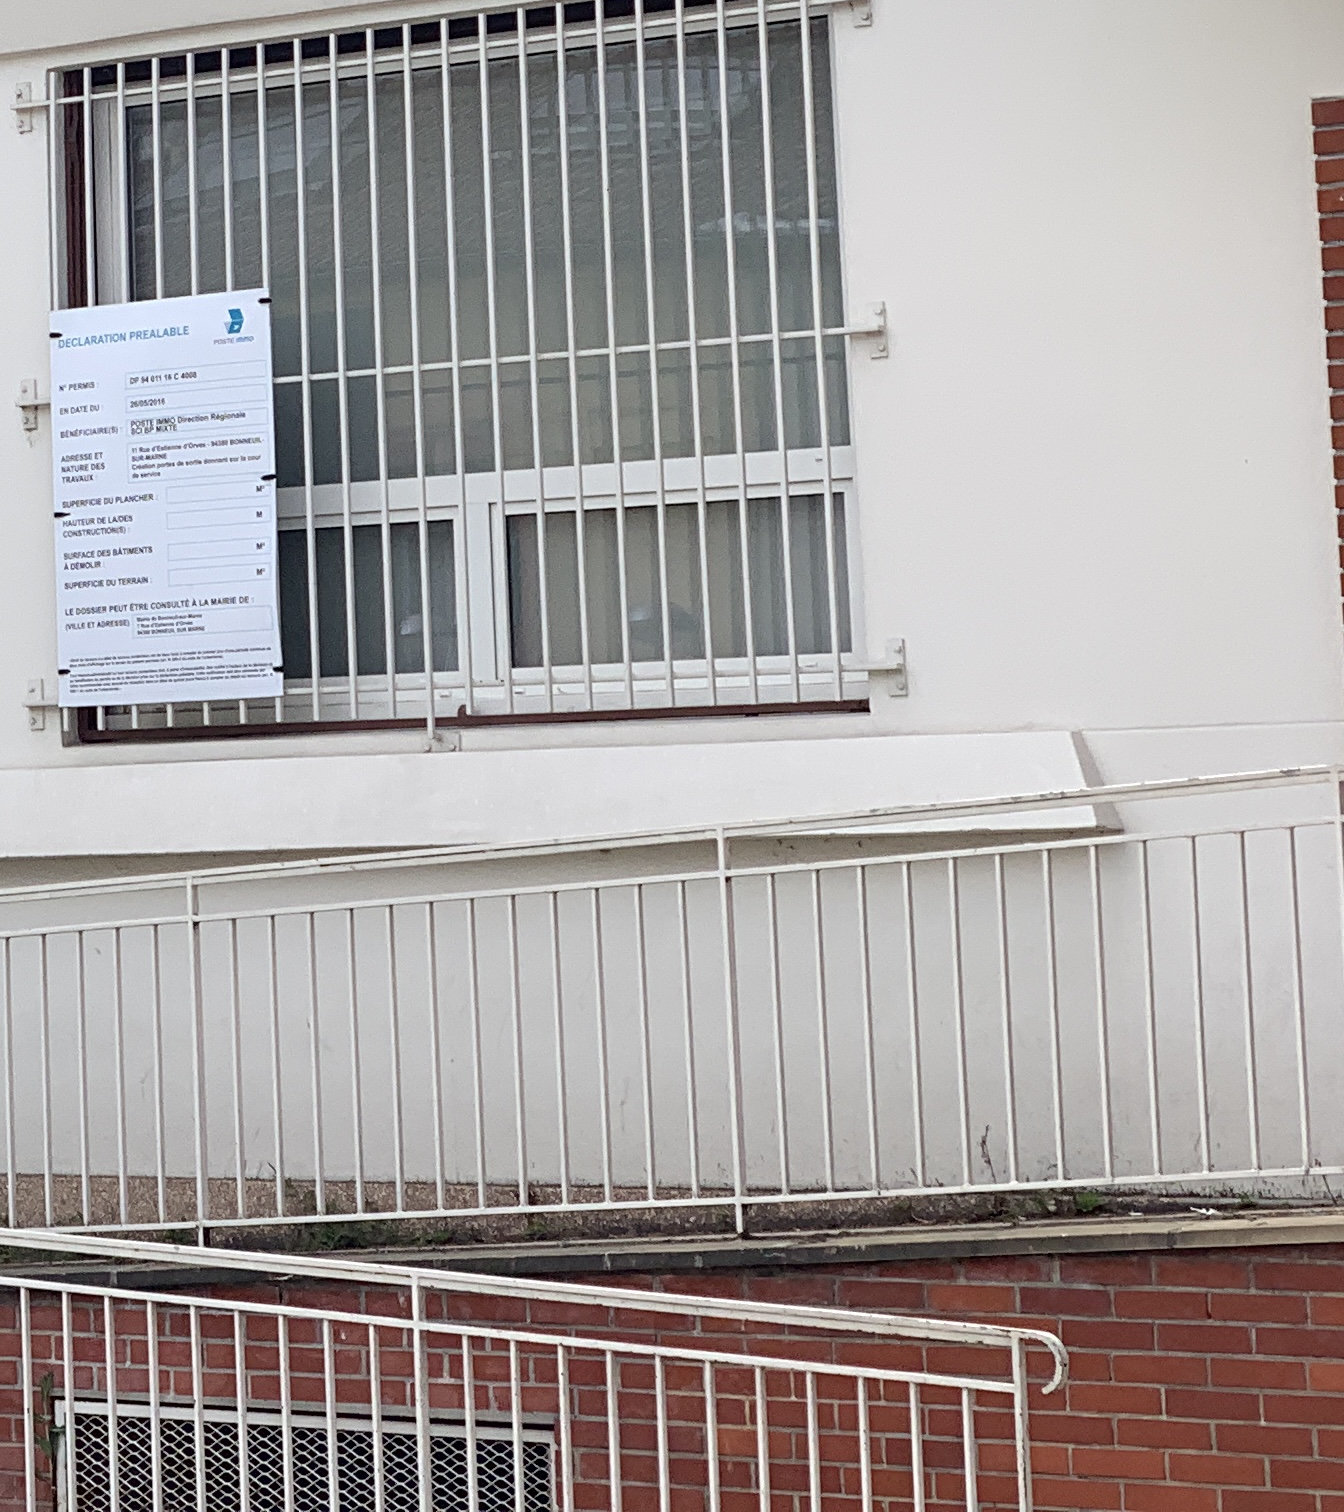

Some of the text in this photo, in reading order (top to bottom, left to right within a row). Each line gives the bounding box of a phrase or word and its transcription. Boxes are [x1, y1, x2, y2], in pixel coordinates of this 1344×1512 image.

[58, 325, 190, 349] DECLARATION PREALABLE
[68, 381, 95, 391] PERMIS
[59, 403, 100, 415] EN DATE DU
[61, 451, 104, 463] ADRESSE ET
[61, 462, 106, 473] NATURE DES
[62, 474, 94, 484] TRAVAUX
[62, 493, 155, 509] SUPERFICIE DU PLANCHER
[256, 510, 263, 518] M
[62, 517, 95, 528] HAUTEUR
[97, 516, 107, 524] DE
[63, 550, 96, 560] SURFACE
[97, 549, 112, 558] DES
[64, 576, 149, 590] SUPERFICIE DU TERRAIN
[65, 608, 74, 616] LE
[75, 605, 108, 616] DOSSIER
[108, 604, 129, 613] PEUT
[198, 598, 209, 607] LA
[238, 595, 250, 604] DE
[87, 621, 96, 629] ET
